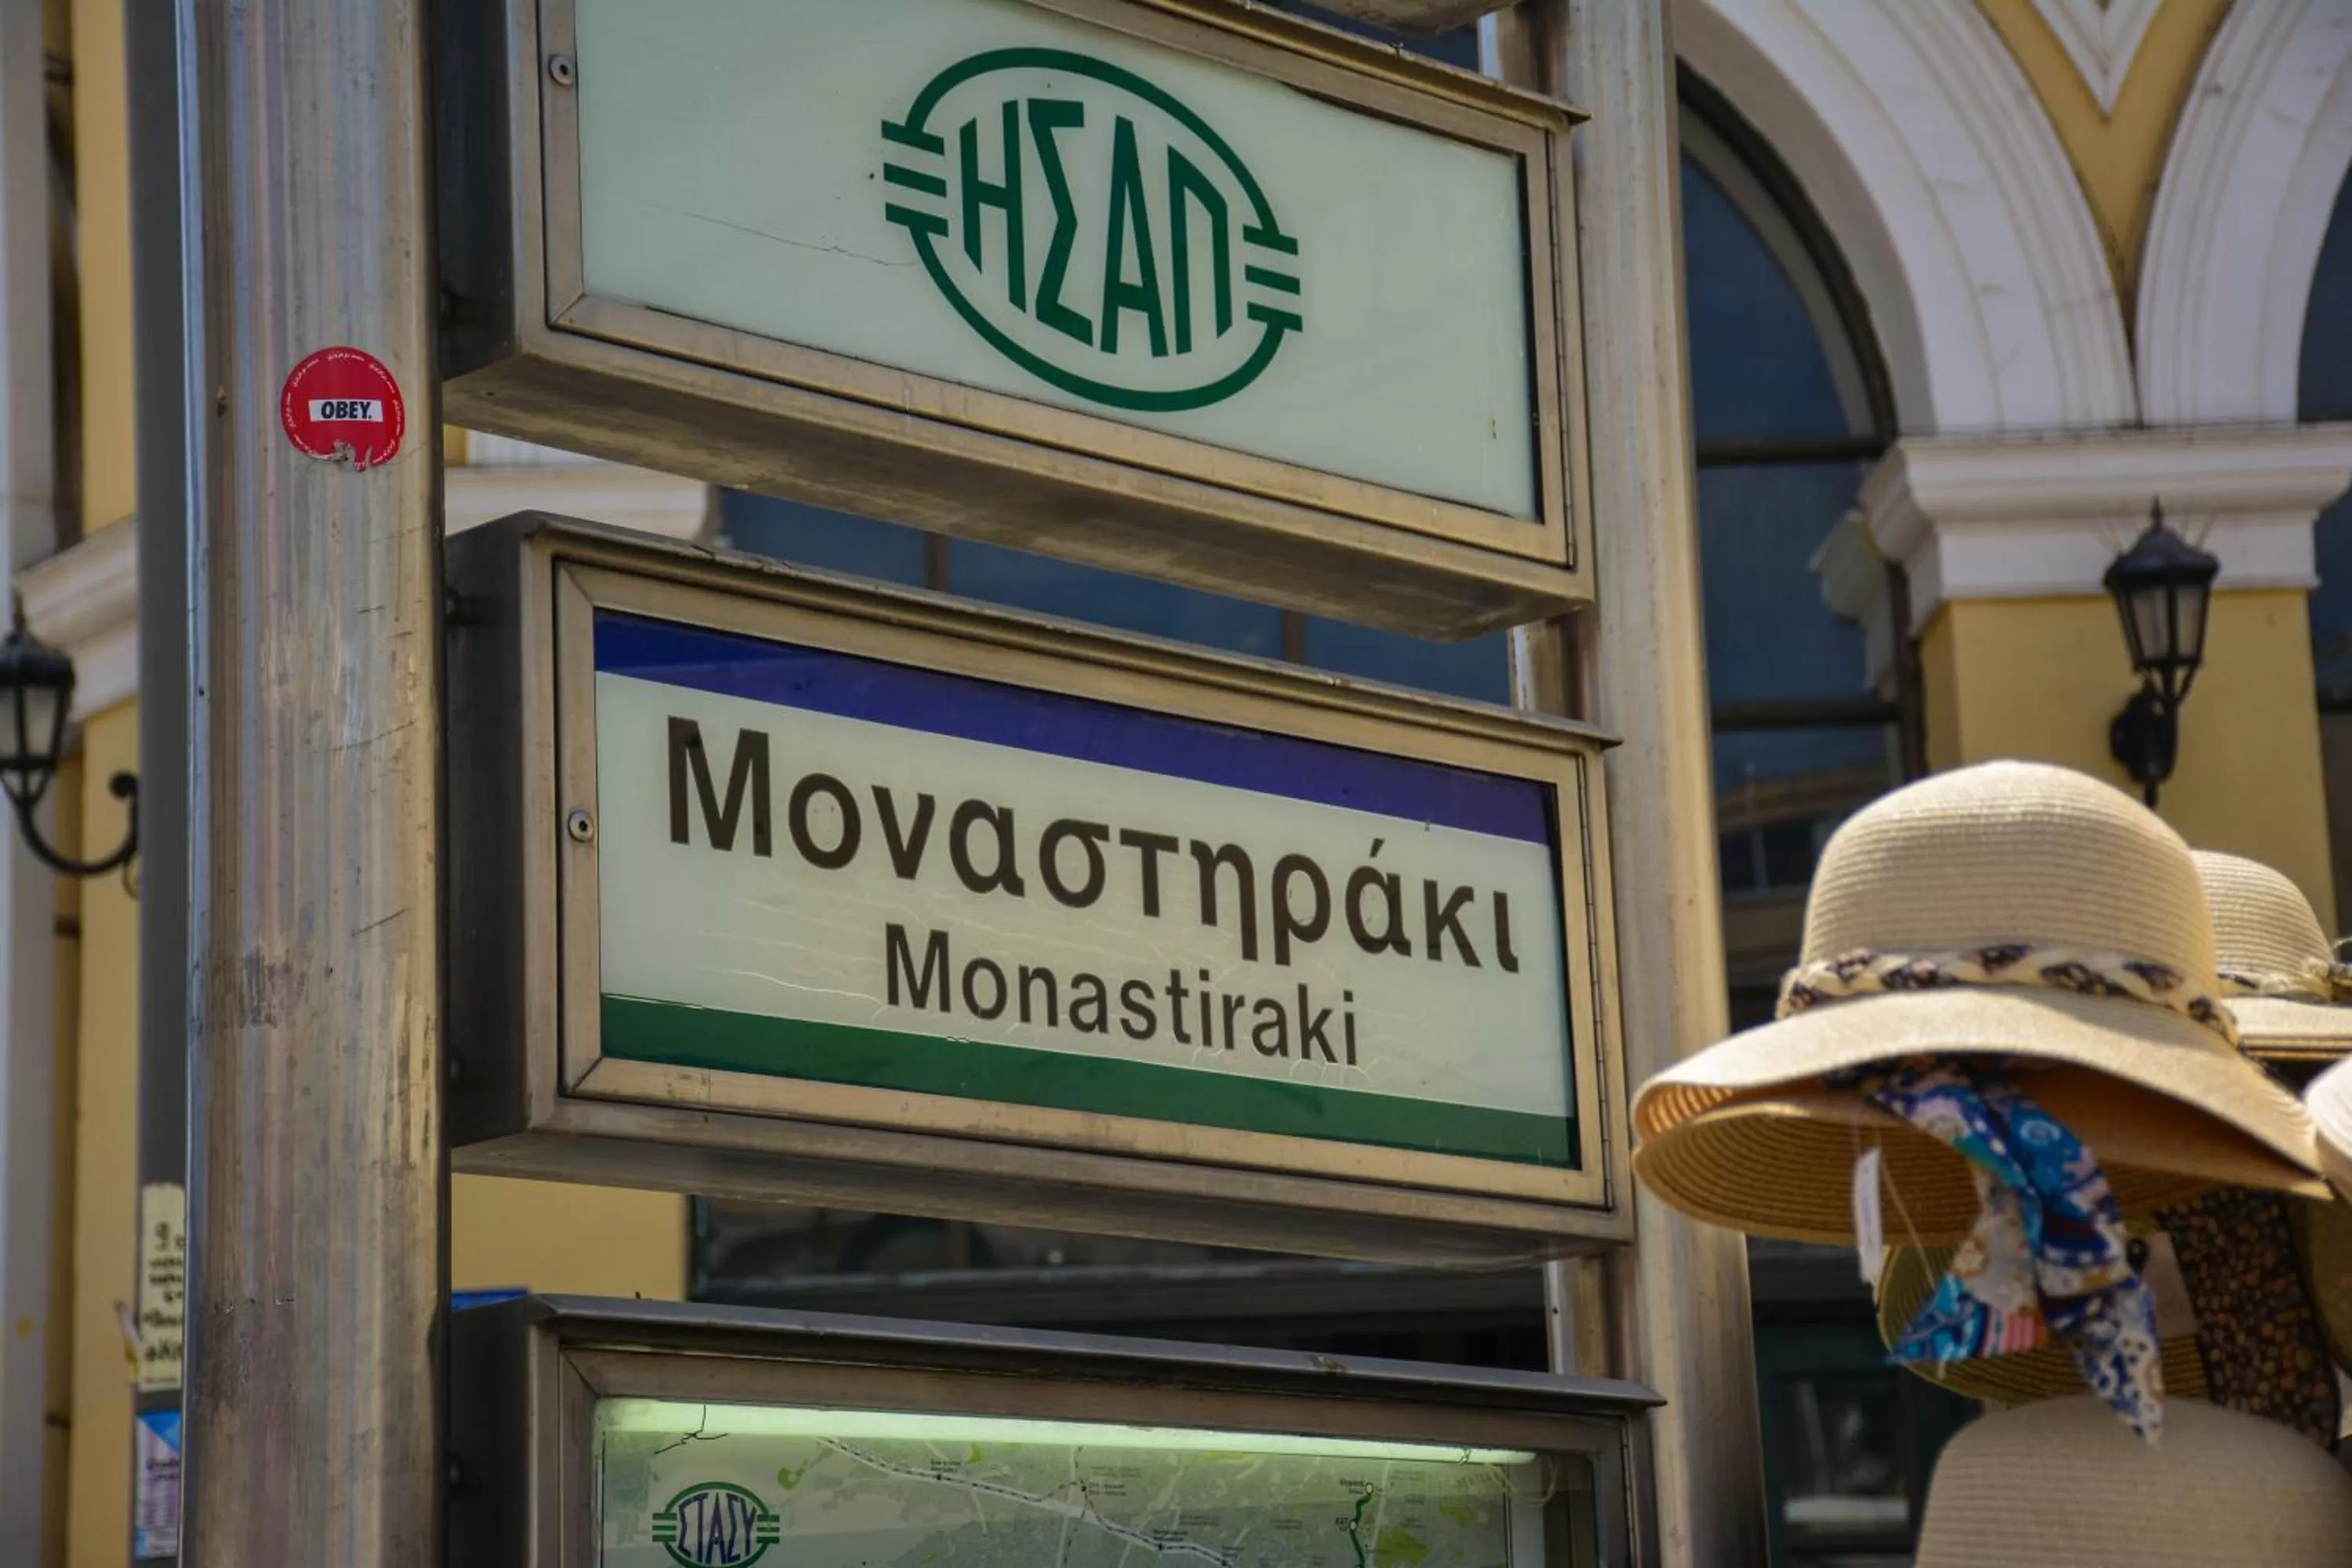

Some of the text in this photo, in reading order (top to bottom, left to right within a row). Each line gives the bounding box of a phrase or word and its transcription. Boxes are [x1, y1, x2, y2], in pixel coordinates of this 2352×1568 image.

[960, 99, 1232, 358] ΗΣΑΠ
[668, 715, 1519, 974] Μοναστηράκι
[885, 923, 1357, 1065] Monastiraki
[677, 1492, 757, 1564] ΣΤΑΣΥ
